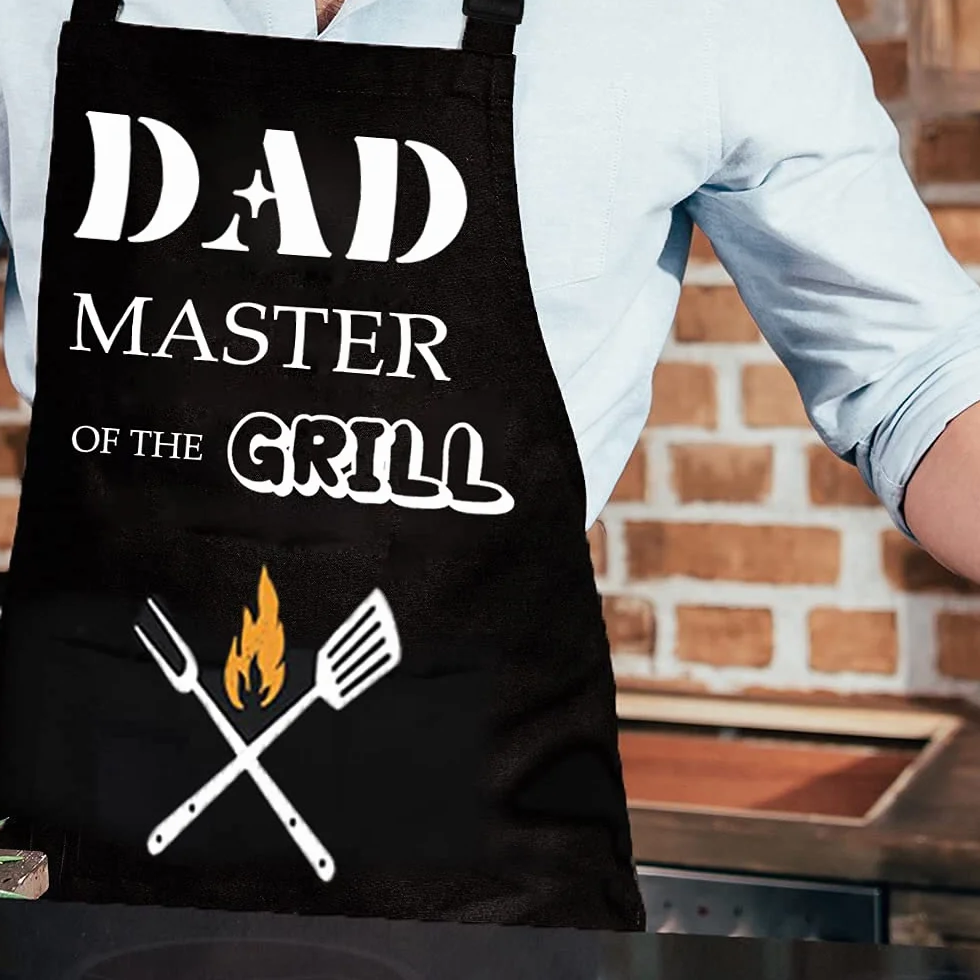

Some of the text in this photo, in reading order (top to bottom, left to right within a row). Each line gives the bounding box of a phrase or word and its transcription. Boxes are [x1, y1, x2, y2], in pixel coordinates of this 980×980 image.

[74, 111, 468, 263] DAD
[70, 293, 451, 381] MASTER
[72, 412, 514, 515] OF THE GRILL
